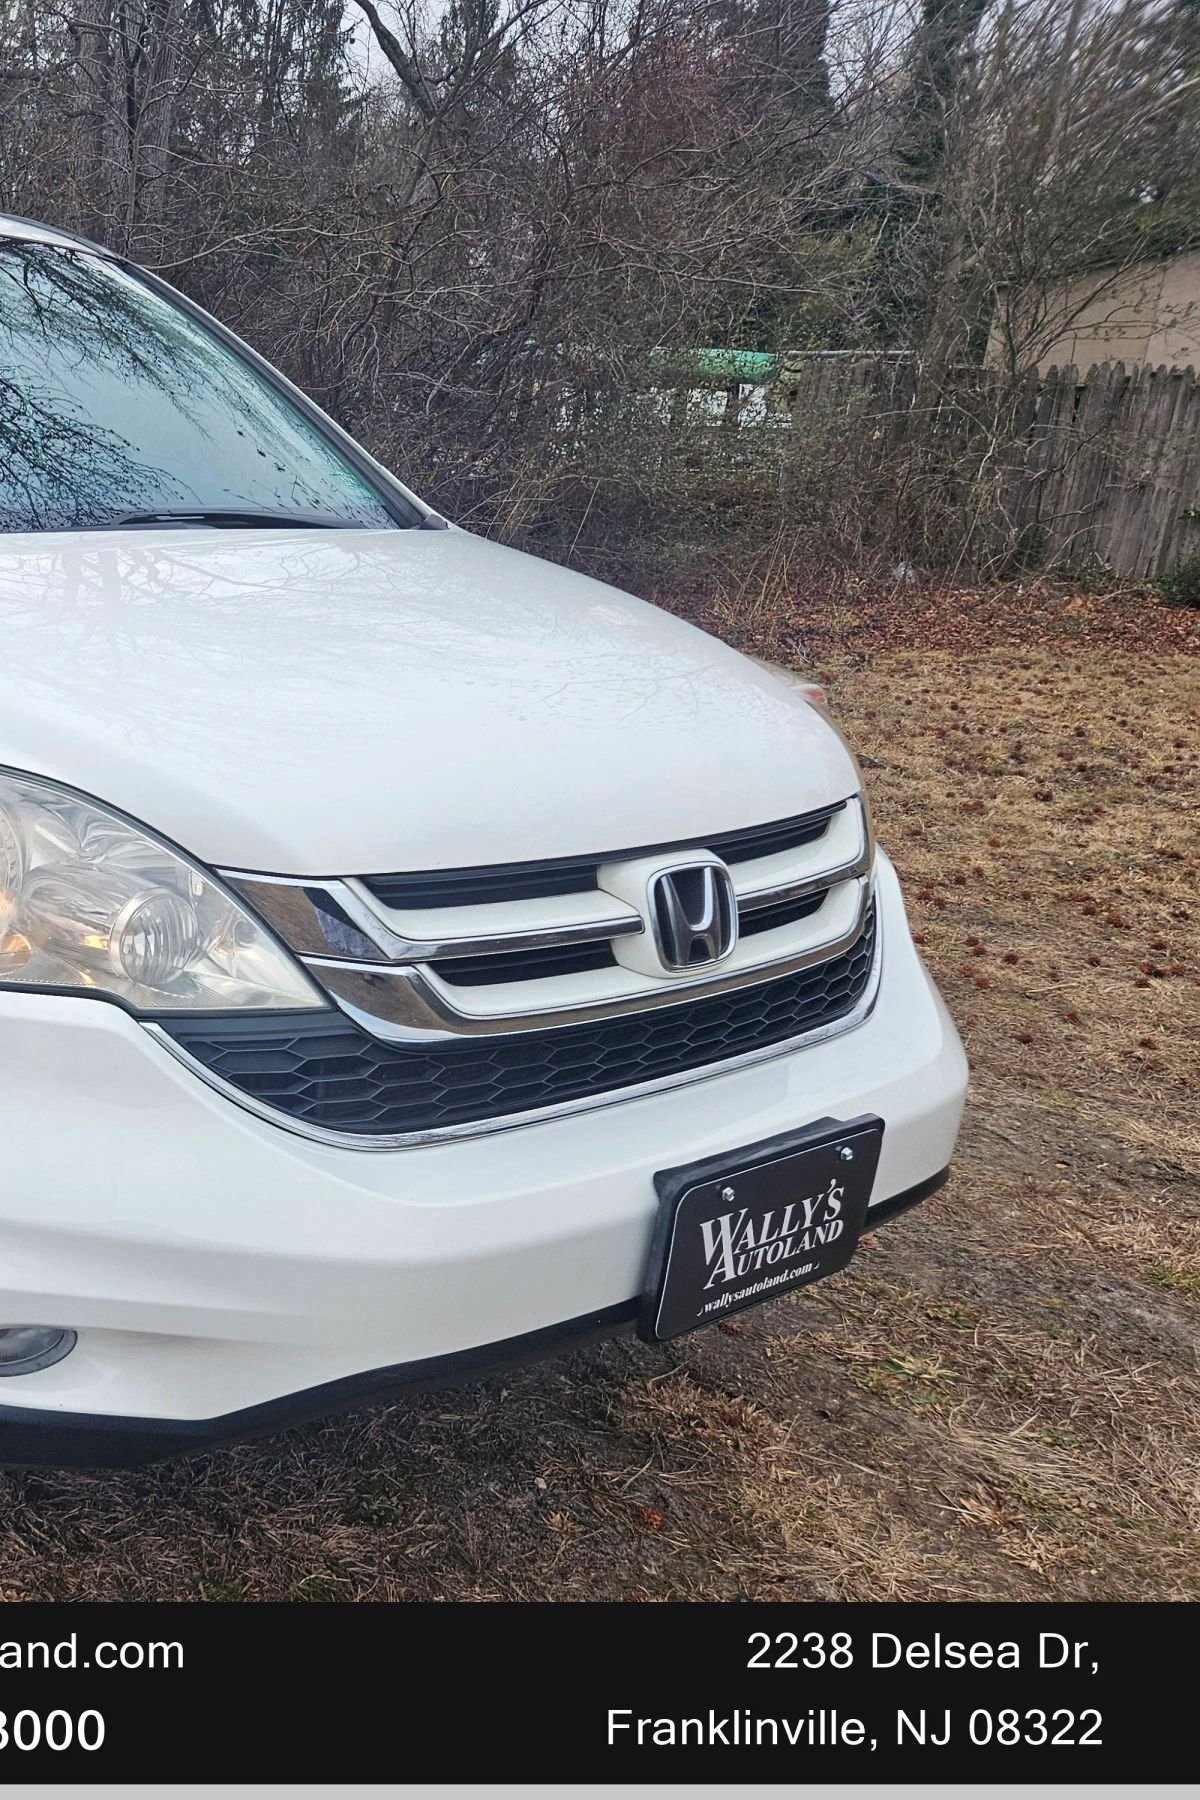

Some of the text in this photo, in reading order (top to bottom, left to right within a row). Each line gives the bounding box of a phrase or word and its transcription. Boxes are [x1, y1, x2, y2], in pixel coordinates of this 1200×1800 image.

[700, 1178, 845, 1266] WALLY'S
[703, 1219, 844, 1290] AUTOLAND
[704, 1262, 813, 1312] wallysautoland.com
